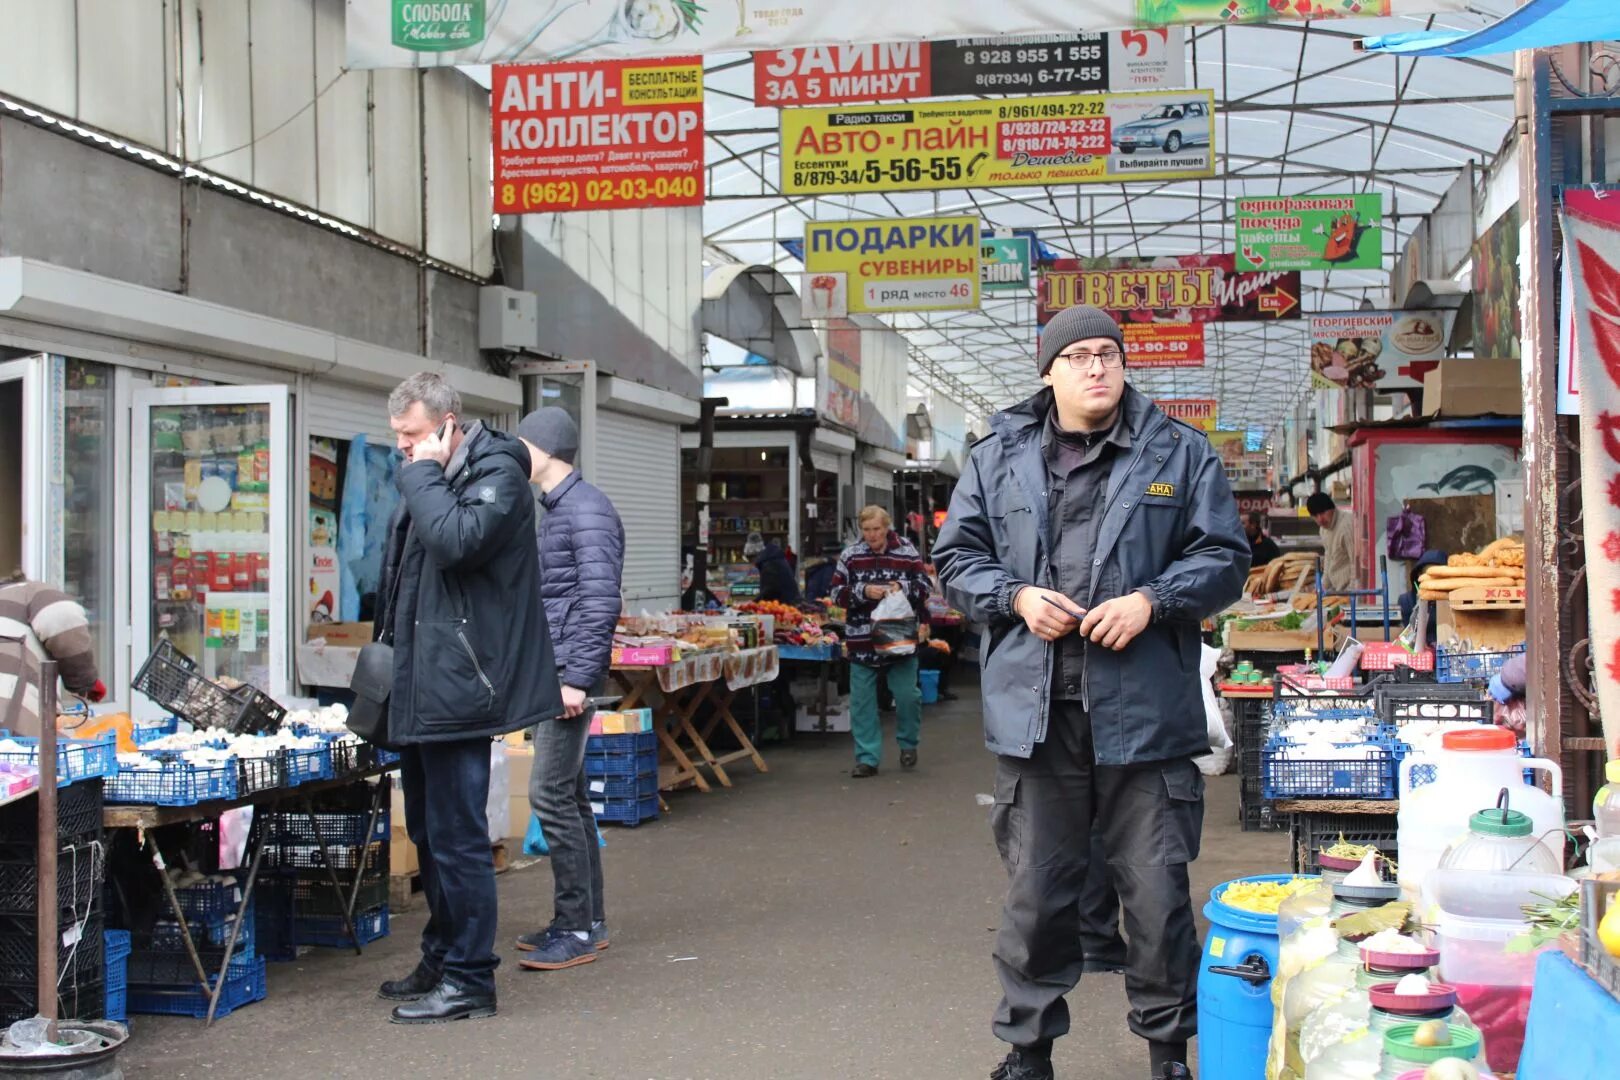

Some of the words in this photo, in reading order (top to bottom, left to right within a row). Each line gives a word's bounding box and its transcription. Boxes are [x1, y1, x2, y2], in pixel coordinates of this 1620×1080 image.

[402, 3, 472, 22] СЛОБОДА
[964, 51, 975, 65] 8
[980, 50, 1012, 64] 928
[1016, 48, 1049, 63] 955
[1053, 47, 1063, 62] 1
[1069, 45, 1101, 61] 555
[628, 70, 697, 86] БЕСПЛАТНЫЕ
[975, 73, 1034, 87] 8(87934)
[1037, 67, 1102, 83] 6-77-55
[500, 70, 617, 112] АНТИ-
[628, 87, 698, 100] КОНСУЛЬТАЦИИ
[765, 79, 799, 101] ЗА
[806, 77, 822, 99] 5
[829, 71, 921, 97] МИНУТ
[836, 113, 871, 125] Радио
[875, 111, 906, 123] такси
[999, 102, 1104, 118] 8/961/494-22-22
[501, 111, 698, 150] КОЛЛЕКТОР
[1002, 119, 1105, 136] 8/928/724-22-22
[1003, 135, 1105, 152] 8/918/74-74-222
[794, 160, 848, 170] Ессентуки
[1010, 151, 1092, 168] Дешевле
[1119, 159, 1169, 169] Выбирайте
[988, 169, 1042, 181] только
[1047, 165, 1104, 179] пешком!
[502, 183, 515, 206] 8
[522, 180, 579, 209] (962)
[585, 175, 697, 202] 02-03-040
[1240, 196, 1354, 214] одноразовая
[1240, 217, 1301, 231] посуда
[812, 224, 974, 255] ПОДАРКИ
[1240, 232, 1300, 244] пакеты
[859, 258, 974, 277] СУВЕНИРЫ
[868, 289, 876, 300] 1
[881, 289, 910, 301] ряд
[950, 283, 969, 297] 46
[1045, 269, 1217, 310] ЦВЕТЫ
[1313, 316, 1393, 327] ГЕОРГИЕВСКИЙ
[1313, 329, 1382, 338] МЯСОКОМБИНАТ
